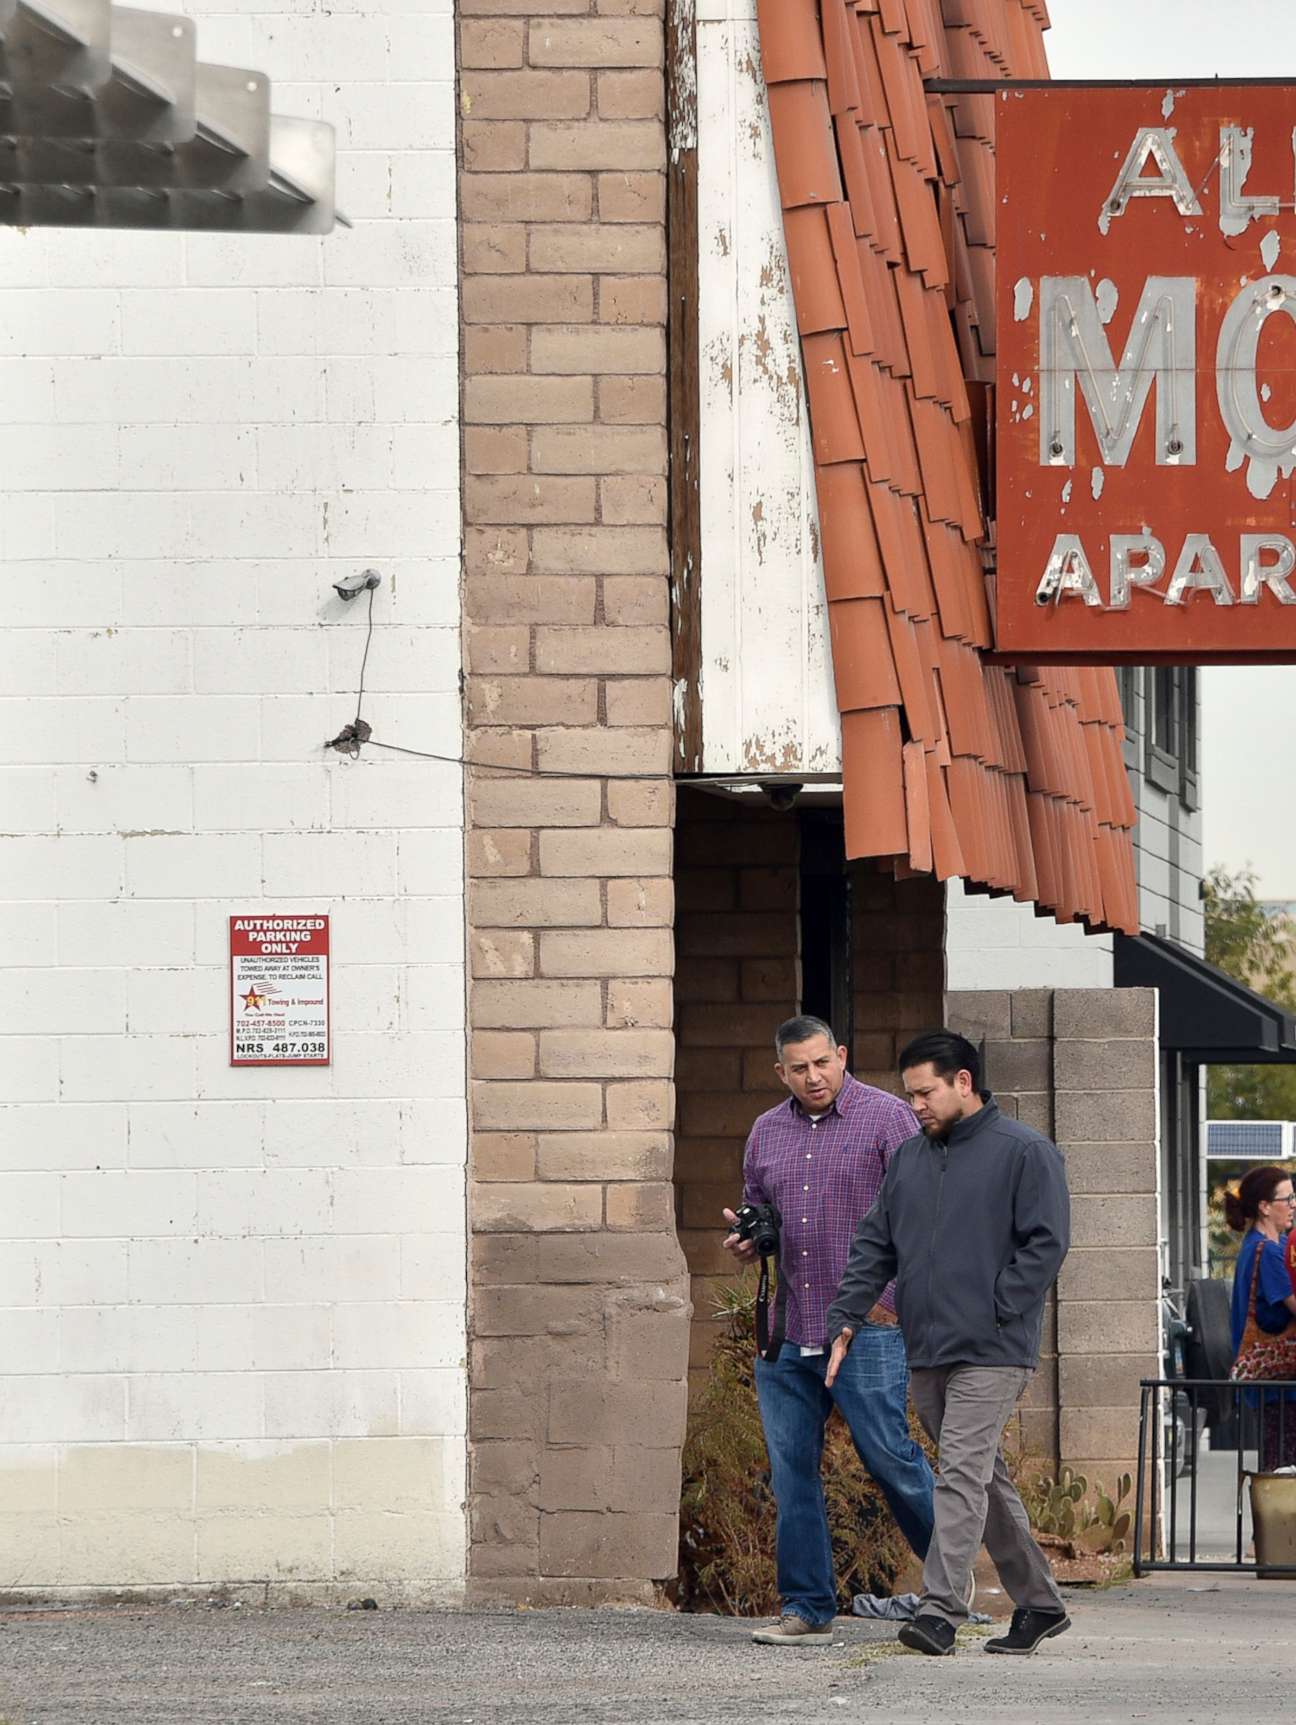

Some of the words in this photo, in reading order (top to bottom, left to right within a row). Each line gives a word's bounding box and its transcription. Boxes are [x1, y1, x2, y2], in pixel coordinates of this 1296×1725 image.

[234, 919, 325, 930] AUTHORIZED
[248, 931, 311, 942] PARKING
[261, 943, 299, 953] ONLY
[236, 1043, 264, 1053] NRS
[272, 1043, 325, 1053] 487.038
